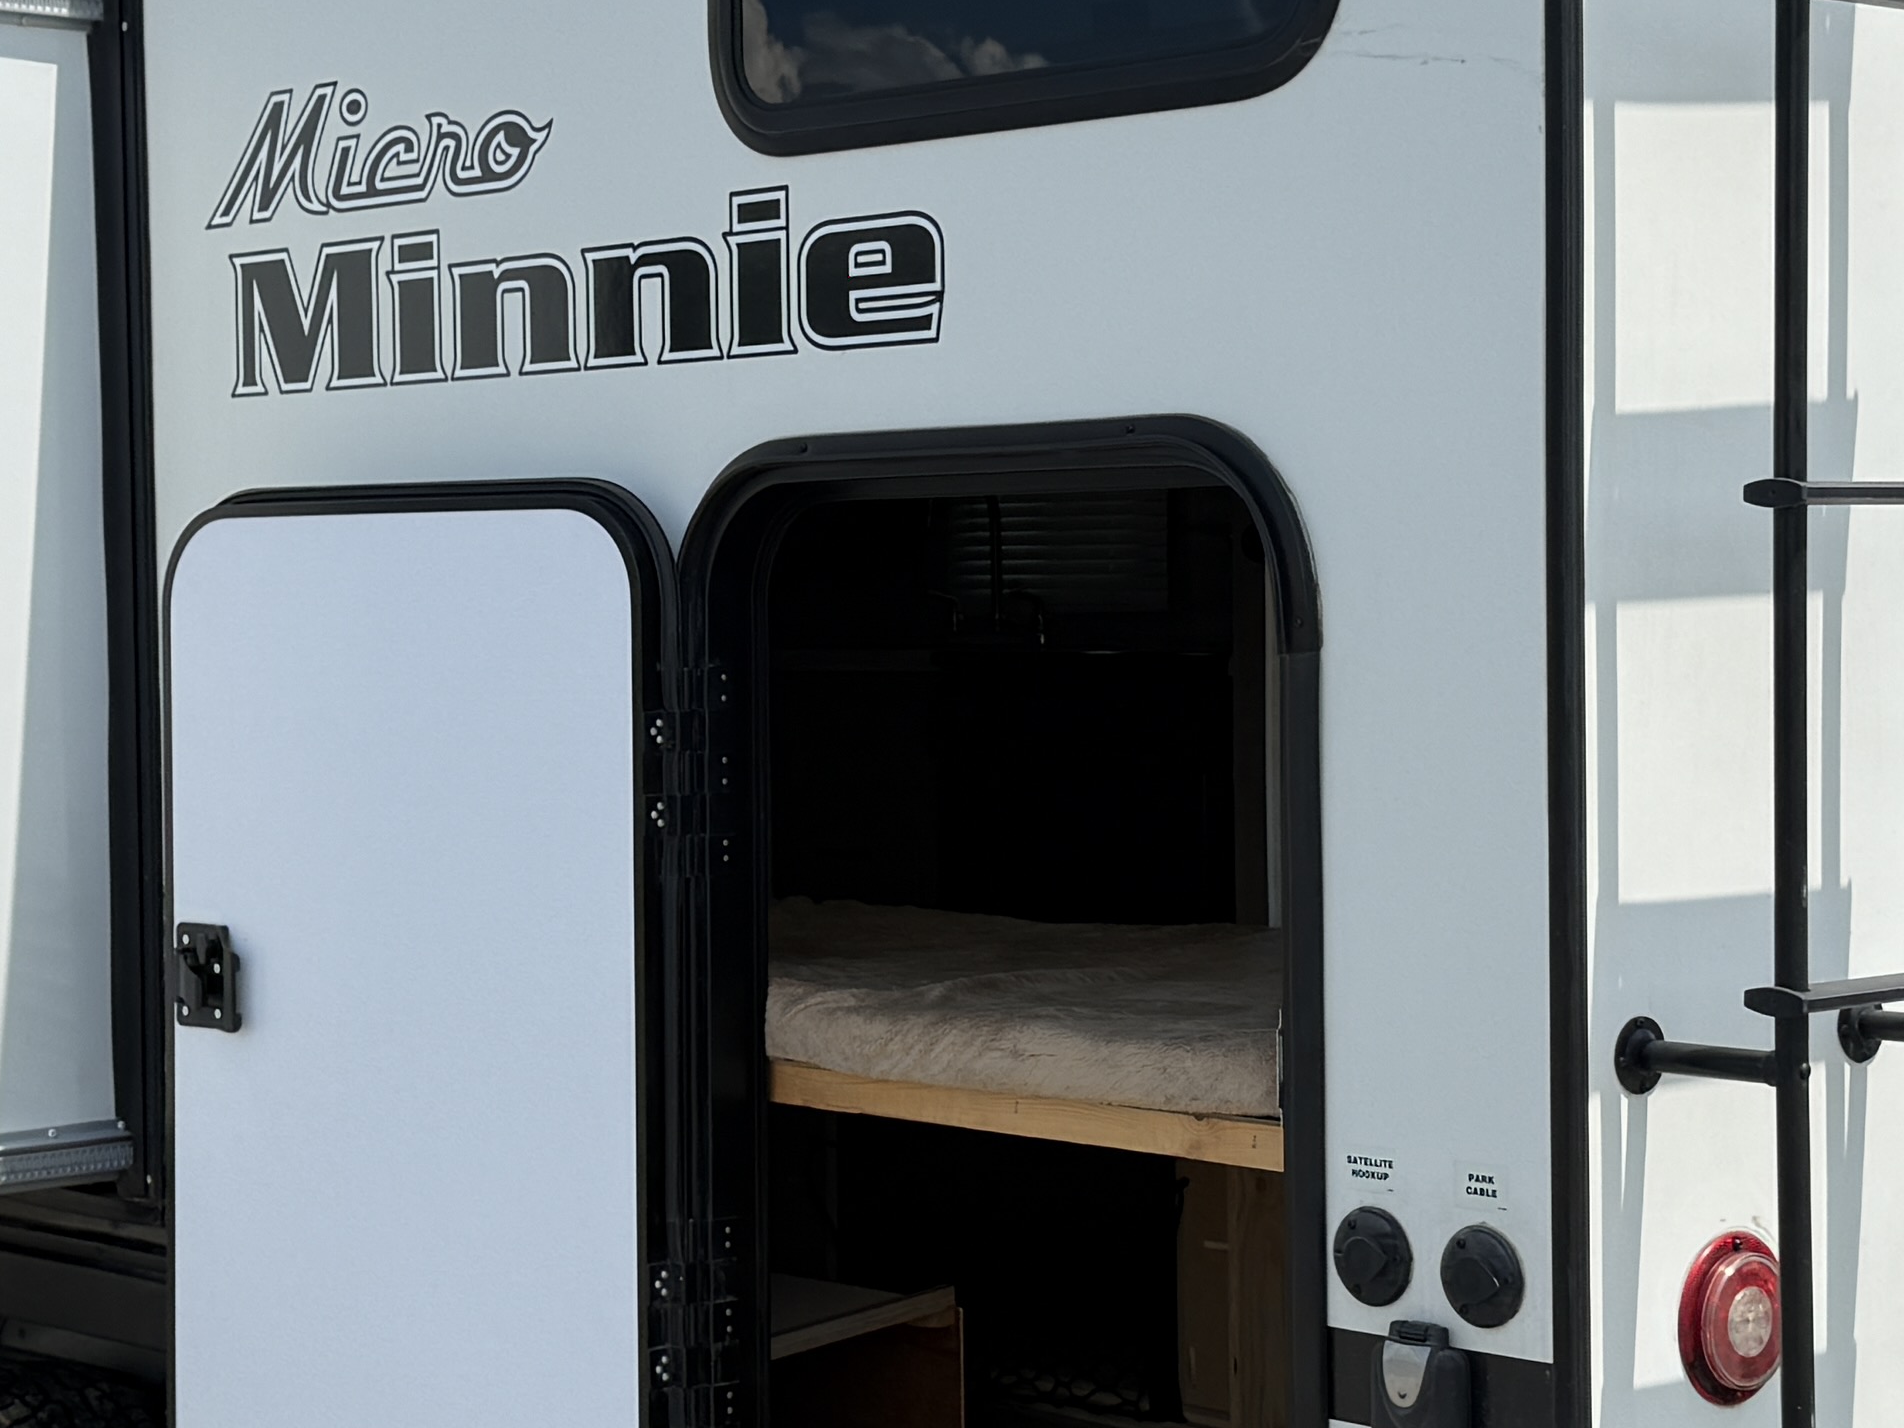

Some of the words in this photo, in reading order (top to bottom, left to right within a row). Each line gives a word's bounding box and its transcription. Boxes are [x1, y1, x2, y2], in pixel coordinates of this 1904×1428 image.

[205, 80, 553, 230] Micro
[229, 184, 946, 399] Minnie
[1346, 1155, 1394, 1169] SATELLITE
[1351, 1169, 1390, 1181] HOOKUP
[1468, 1173, 1495, 1185] PARK
[1465, 1186, 1498, 1198] CABLE
